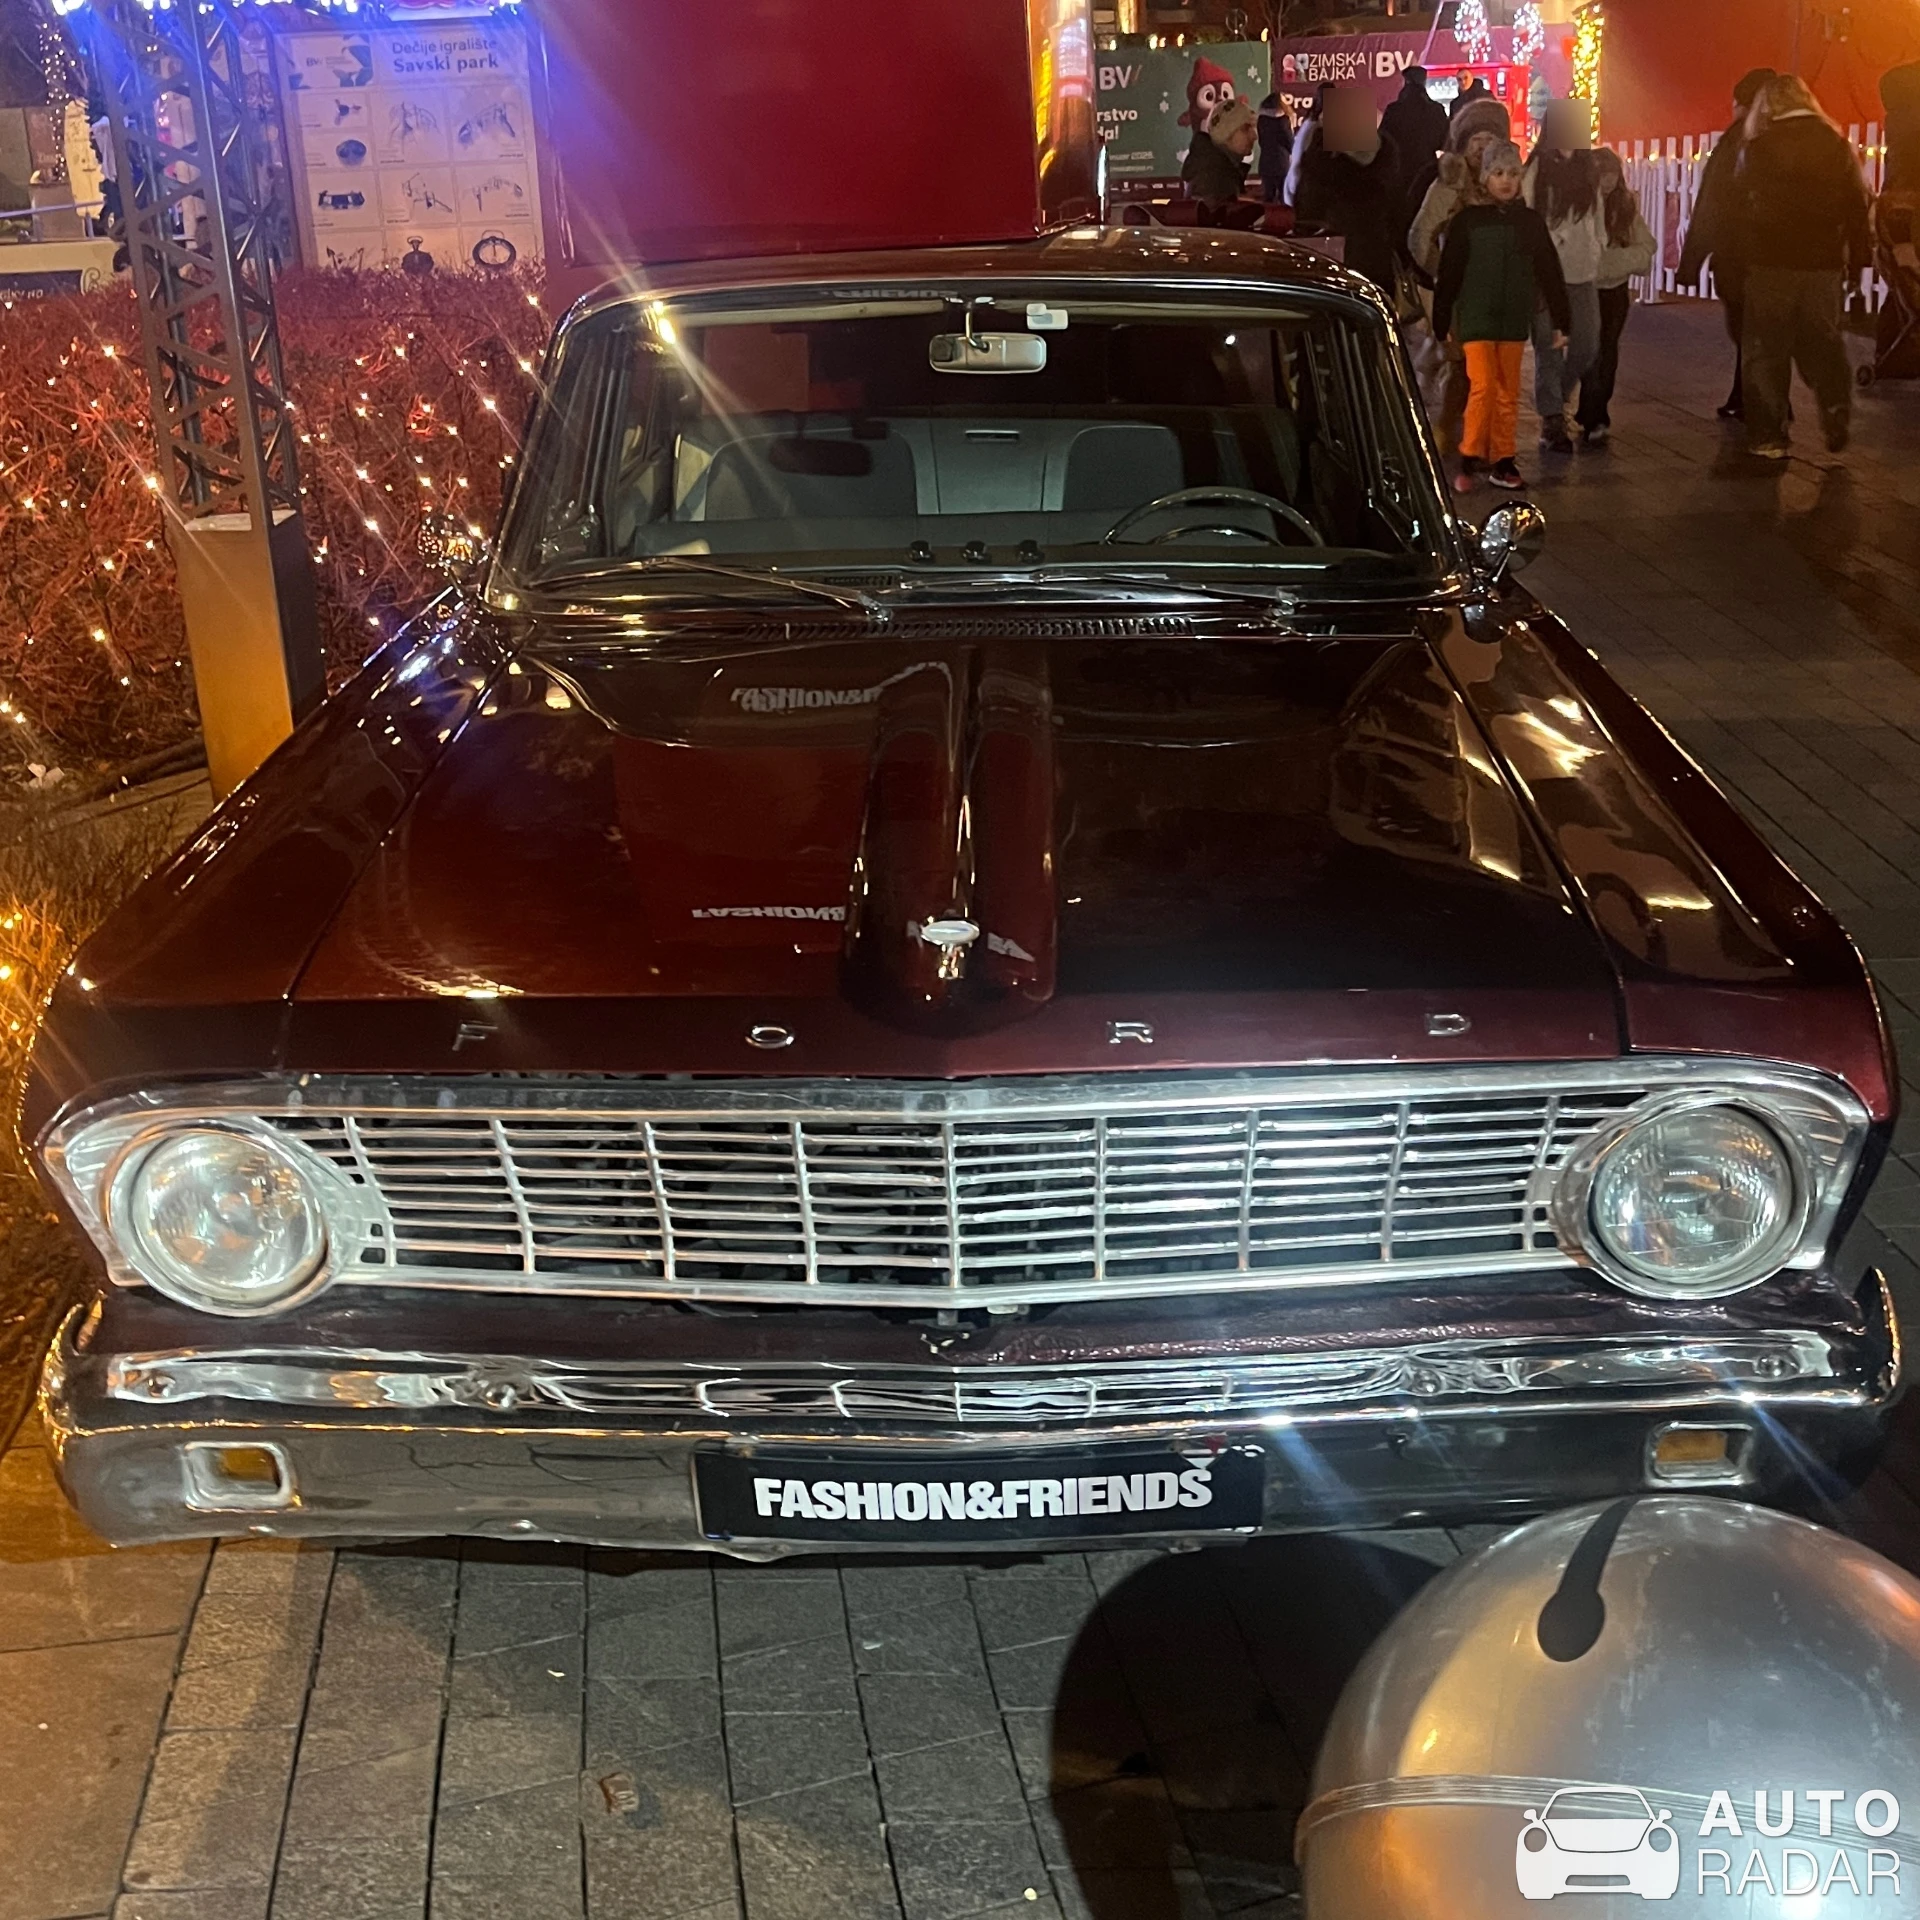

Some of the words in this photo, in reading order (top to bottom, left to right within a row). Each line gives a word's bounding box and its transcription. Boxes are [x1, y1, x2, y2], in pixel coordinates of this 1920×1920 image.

[439, 37, 498, 55] igralište
[394, 55, 451, 73] Savski
[457, 53, 499, 73] park
[1309, 52, 1366, 67] ZIMSKA
[1309, 67, 1356, 82] BAJKA
[753, 1468, 1213, 1521] FASHION&FRIENDS
